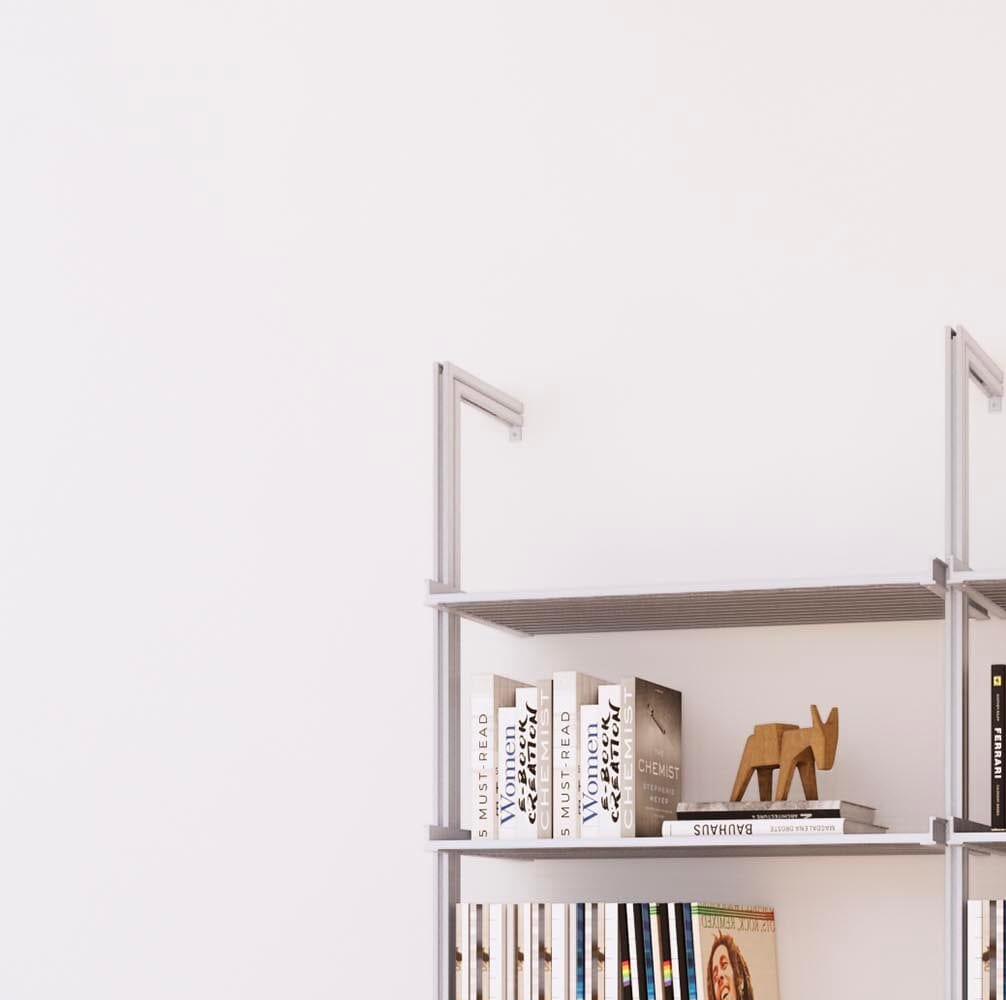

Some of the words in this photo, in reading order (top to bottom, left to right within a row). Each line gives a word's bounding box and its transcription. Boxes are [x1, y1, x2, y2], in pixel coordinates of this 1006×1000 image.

[478, 713, 488, 820] MUST-READ
[500, 726, 516, 825] Women
[518, 716, 529, 812] E-BOOK
[525, 699, 538, 824] CREATION
[541, 688, 550, 830] CHEMIST
[560, 711, 570, 818] MUST-READ
[582, 723, 598, 824] Women
[601, 714, 611, 811] E-BOOK
[609, 699, 621, 823] CREATION
[623, 687, 633, 830] CHEMIST
[638, 758, 680, 780] CHEMIST
[994, 727, 1002, 779] FERRARI
[478, 829, 488, 838] 5
[560, 828, 570, 836] 5
[694, 824, 752, 835] BAUHAUS
